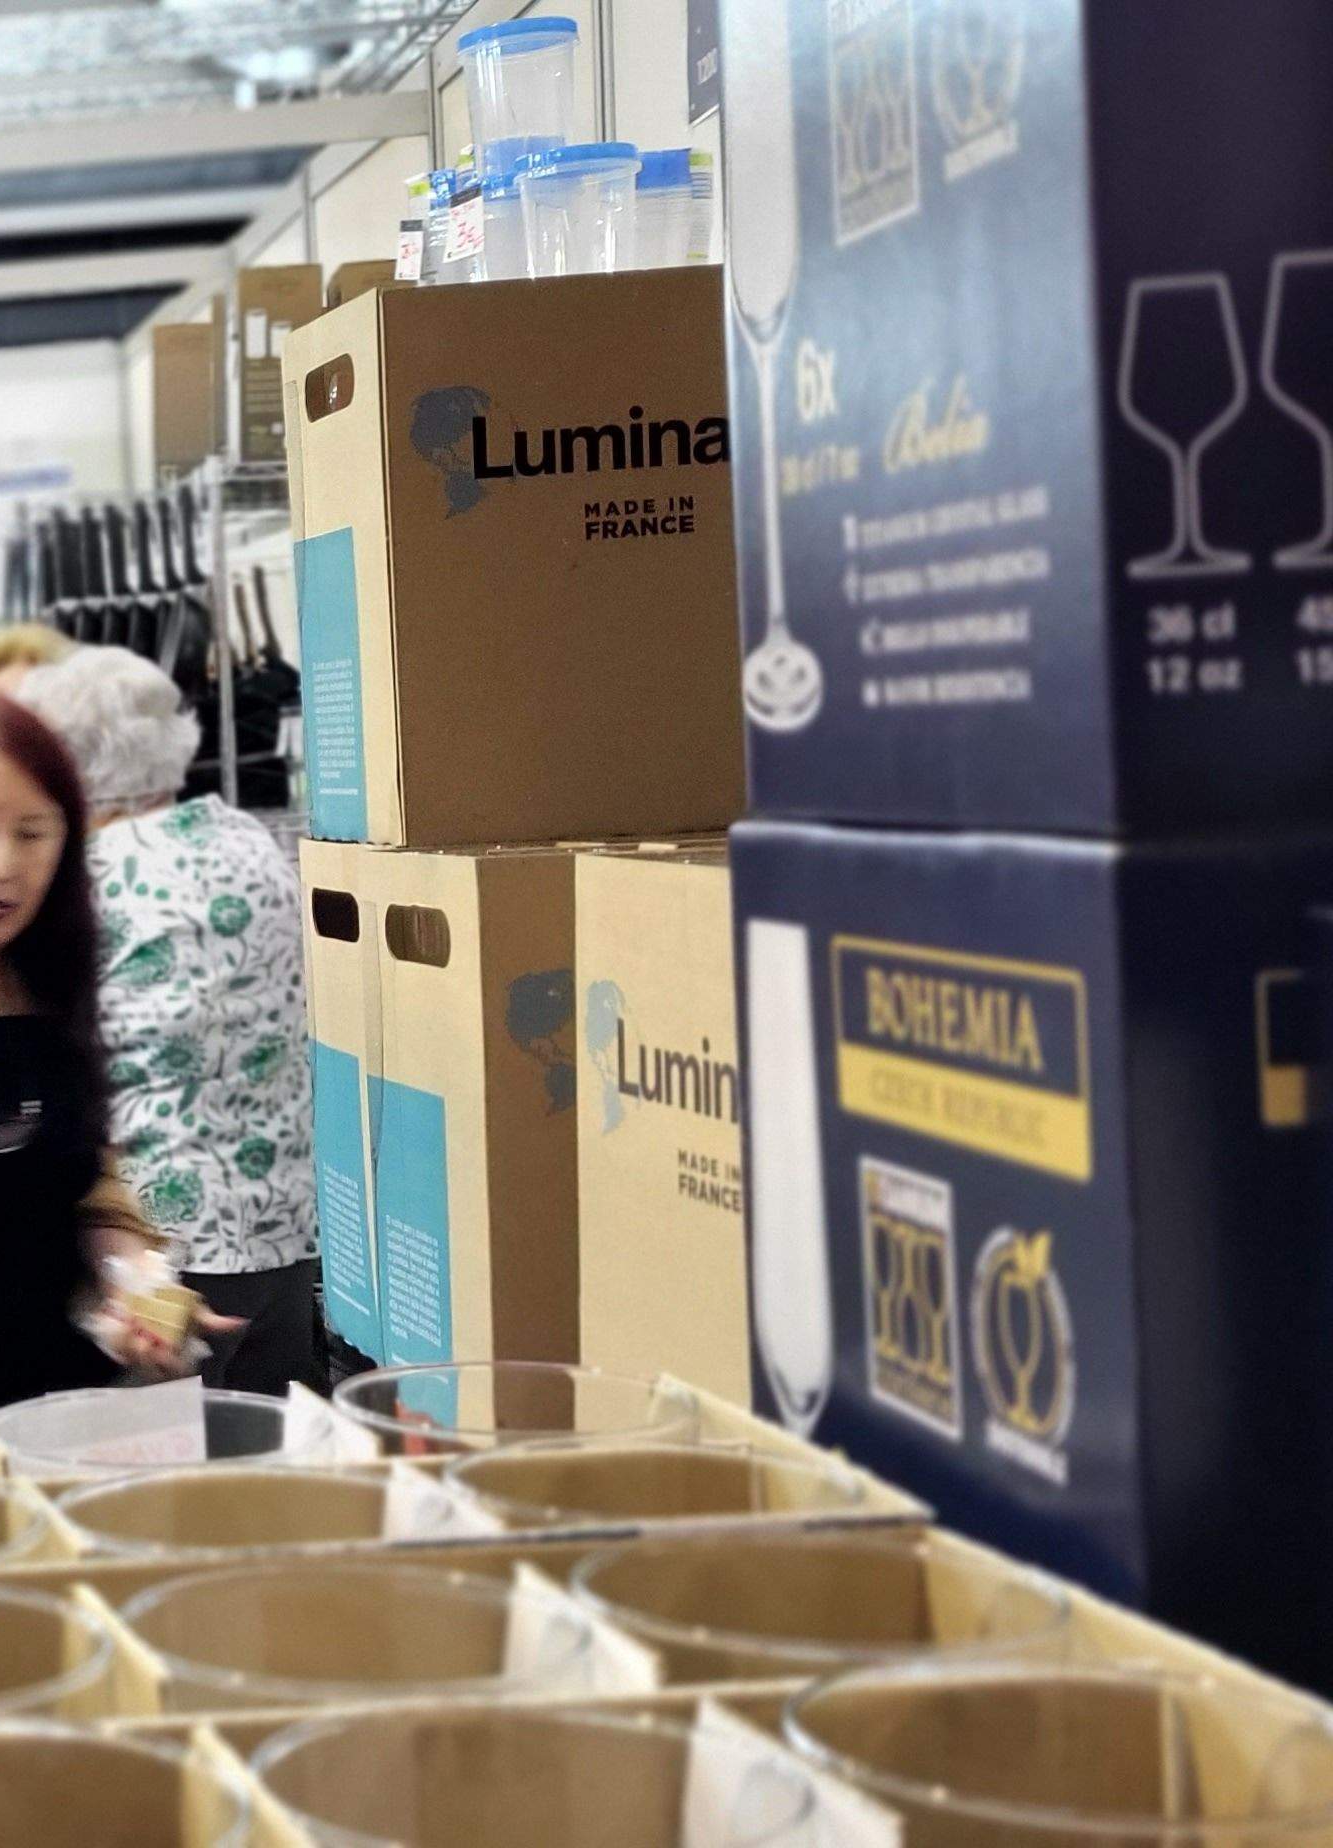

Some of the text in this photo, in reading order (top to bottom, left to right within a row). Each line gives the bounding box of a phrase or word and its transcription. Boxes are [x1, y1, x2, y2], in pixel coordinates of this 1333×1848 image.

[584, 495, 695, 519] MADE IN
[585, 514, 695, 540] FRANCE
[1148, 655, 1241, 692] 12 oz
[866, 966, 1045, 1072] BOHEMIA
[678, 1150, 742, 1184] MADE IN
[678, 1173, 742, 1214] FRANCE
